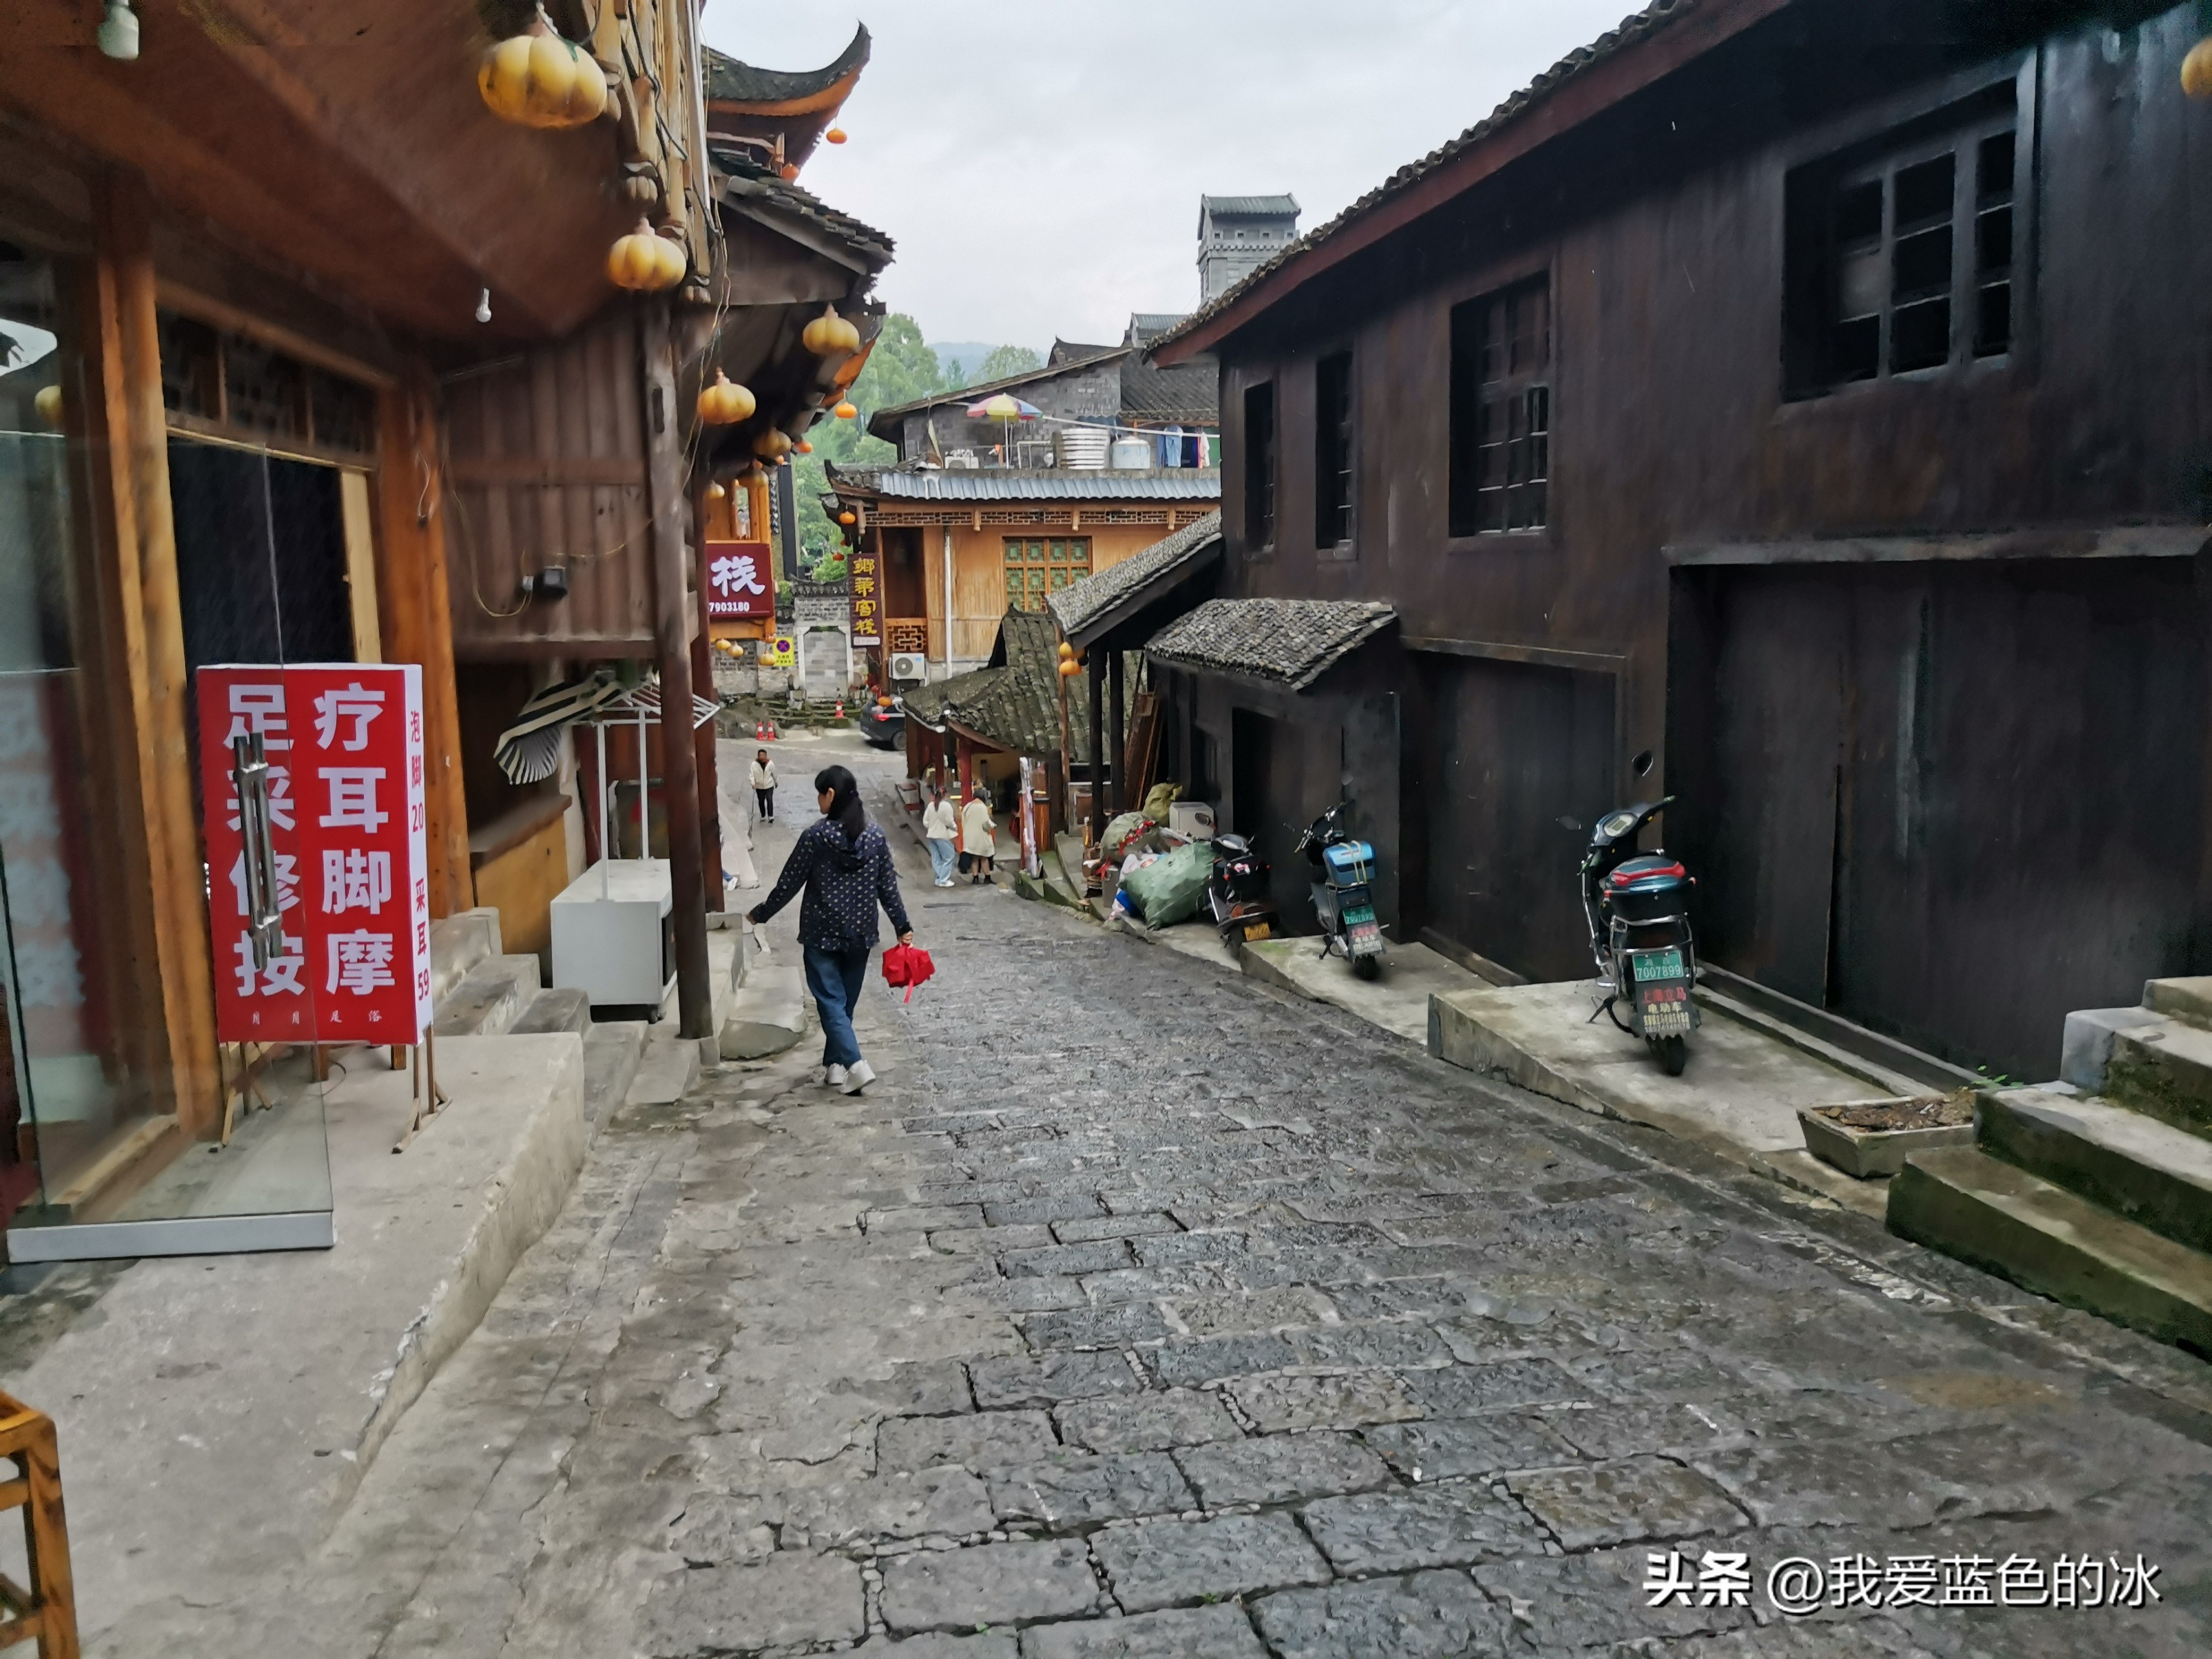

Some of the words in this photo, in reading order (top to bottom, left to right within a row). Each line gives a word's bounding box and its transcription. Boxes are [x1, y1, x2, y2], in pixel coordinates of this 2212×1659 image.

[711, 555, 766, 598] 栈
[222, 682, 386, 751] 足疗
[227, 767, 389, 834] 采耳
[228, 848, 392, 915] 修脚
[233, 928, 396, 997] 按摩
[1636, 964, 1681, 980] 7007899
